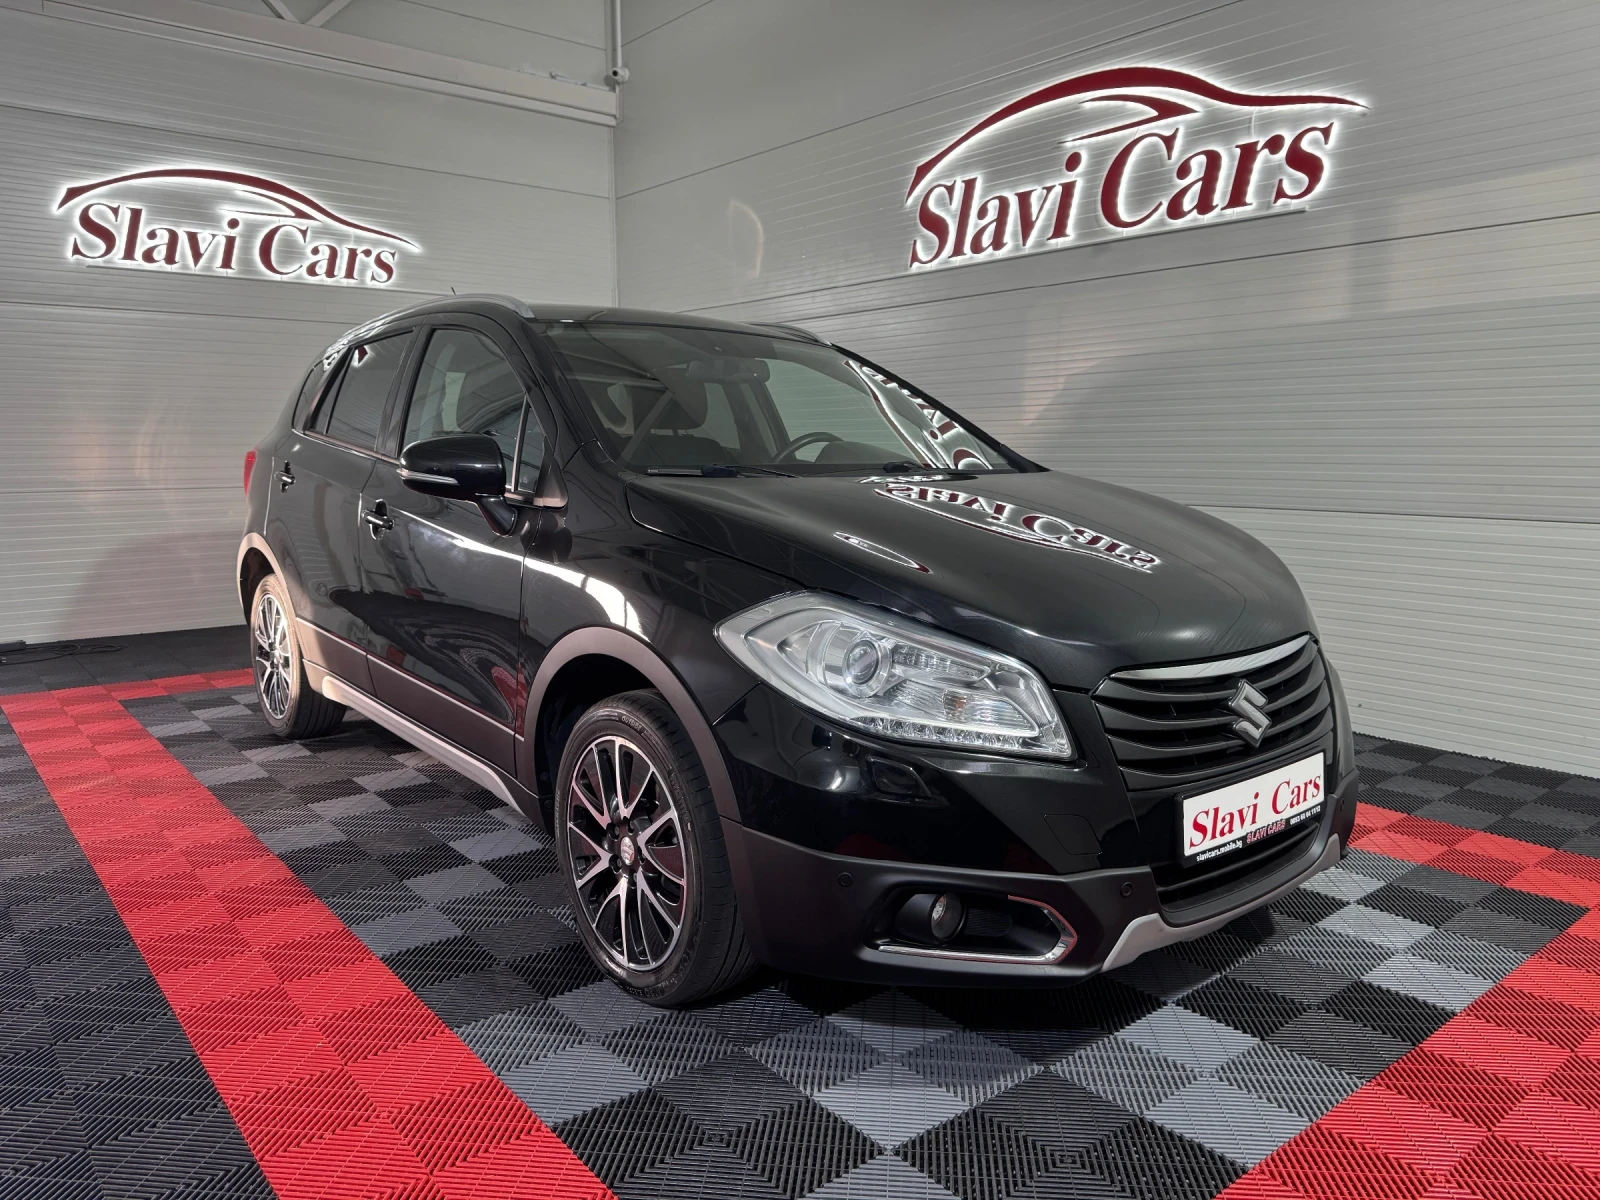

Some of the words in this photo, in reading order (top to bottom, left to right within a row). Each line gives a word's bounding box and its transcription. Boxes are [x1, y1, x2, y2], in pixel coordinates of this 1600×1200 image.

[910, 152, 1082, 267] Slavi
[1100, 122, 1334, 230] Cars
[71, 203, 240, 271] Slavi
[259, 224, 396, 283] Cars
[1189, 791, 1260, 849] Slavi
[1271, 775, 1321, 815] Cars
[1196, 839, 1243, 862] slavicars.mobile.bg
[1246, 826, 1267, 844] SLAVI
[1268, 819, 1286, 836] CARS
